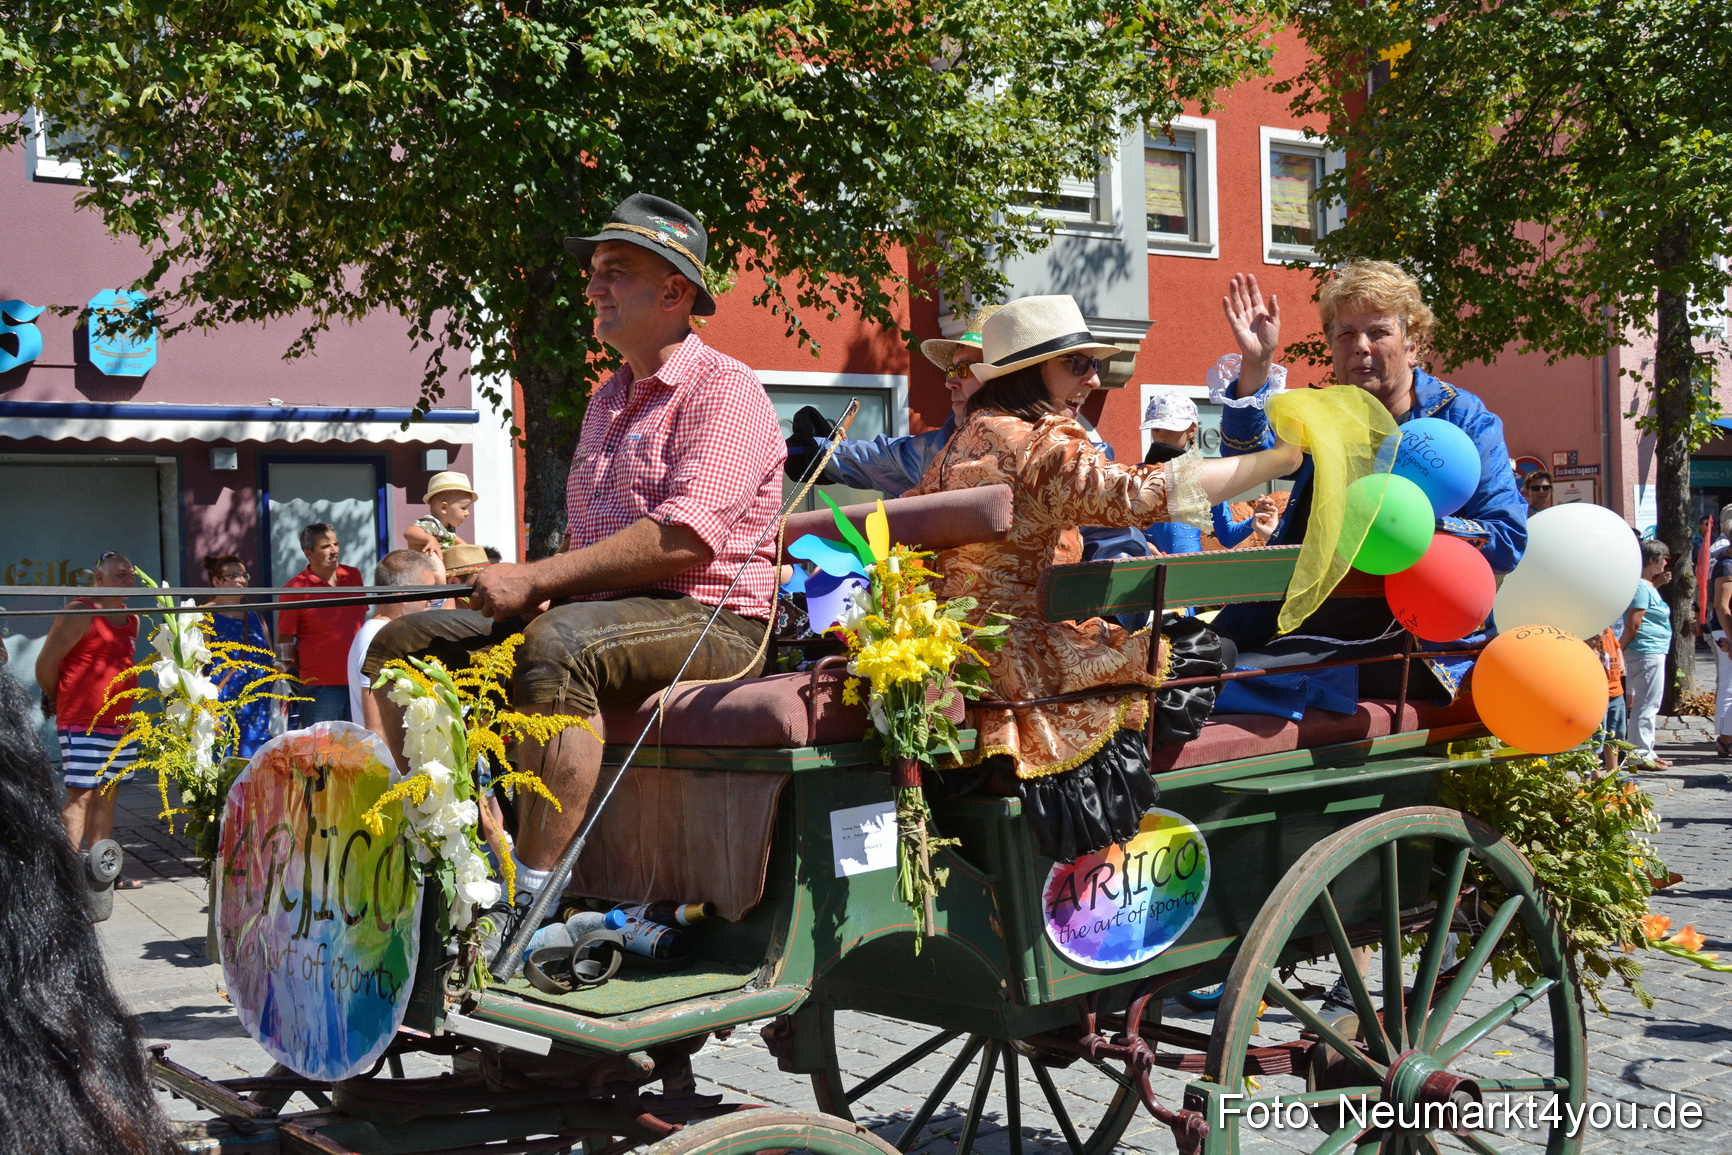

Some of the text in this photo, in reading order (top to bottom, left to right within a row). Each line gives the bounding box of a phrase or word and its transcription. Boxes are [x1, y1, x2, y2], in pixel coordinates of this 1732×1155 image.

[1058, 890, 1201, 945] the art of sports
[302, 942, 328, 993] of
[331, 956, 403, 1006] sports
